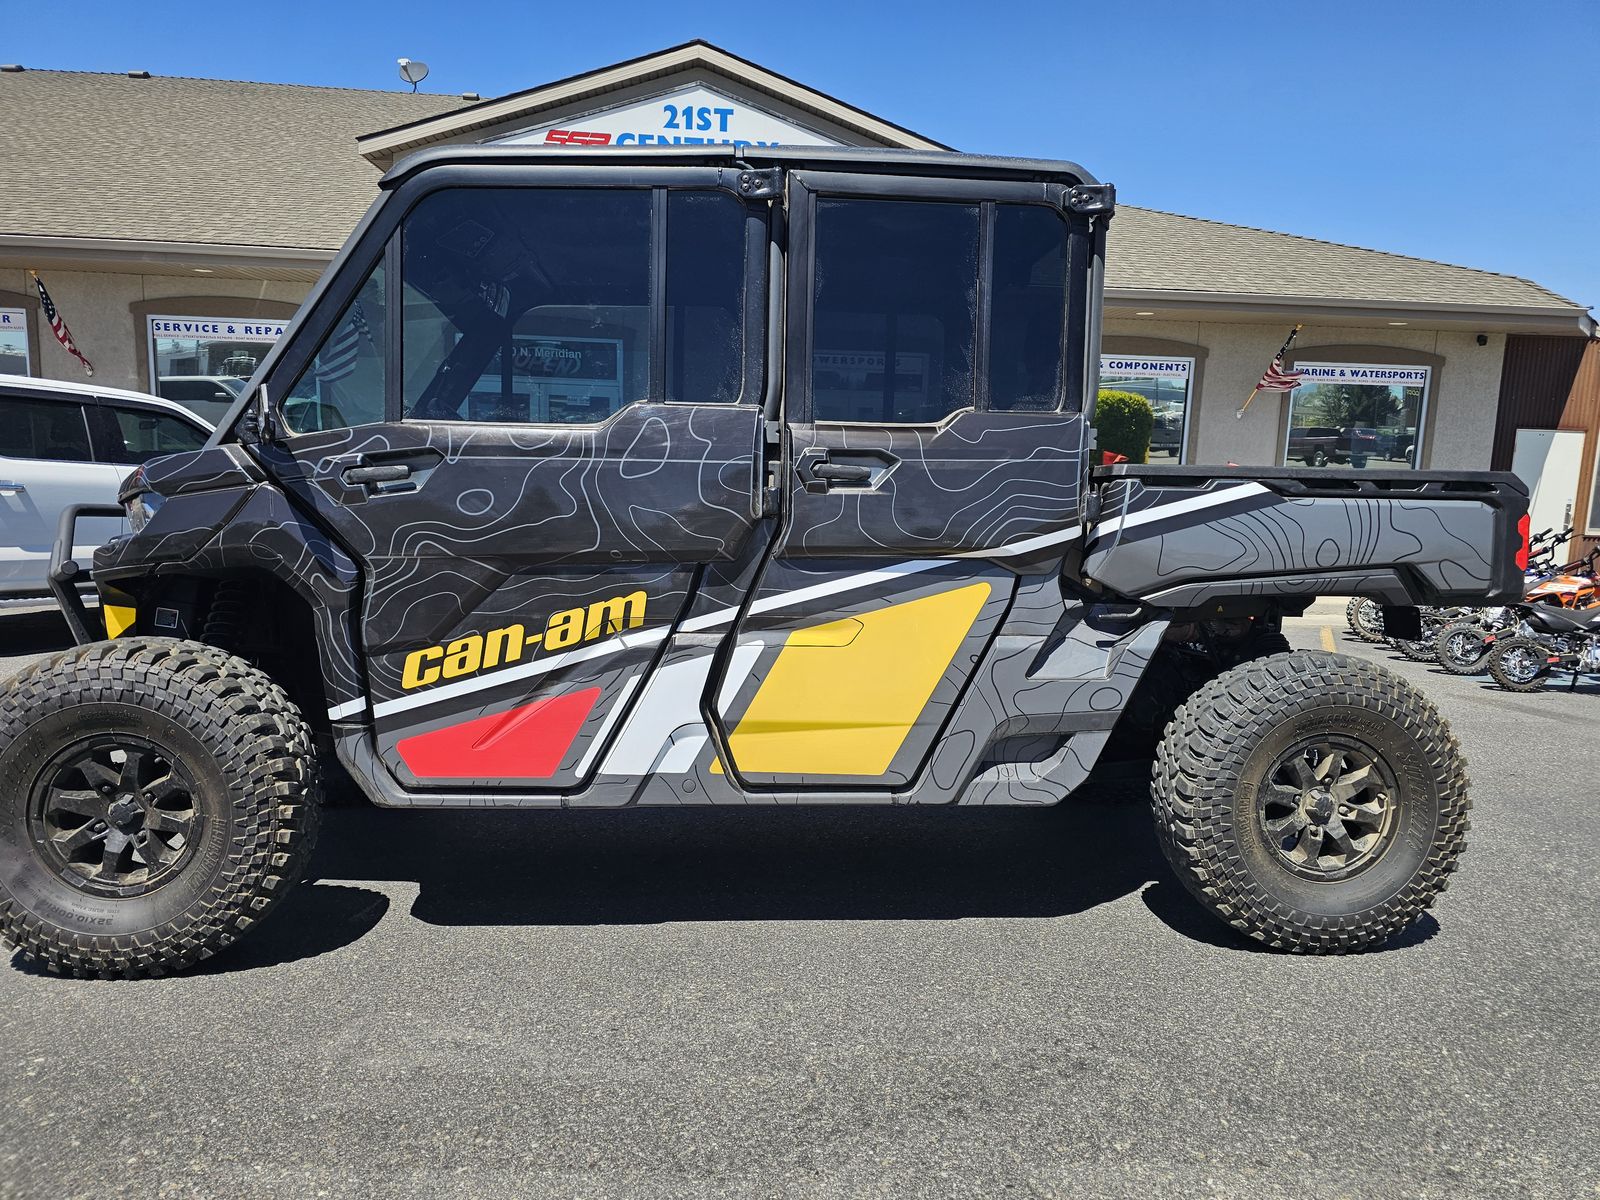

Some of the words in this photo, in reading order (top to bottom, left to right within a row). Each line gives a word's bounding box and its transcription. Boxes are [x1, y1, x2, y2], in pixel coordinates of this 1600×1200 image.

[663, 104, 735, 133] 21ST
[155, 322, 219, 333] SERVICE
[227, 325, 236, 334] &
[534, 347, 582, 359] Meridian
[1108, 361, 1187, 372] COMPONENTS
[1339, 369, 1346, 377] &
[1350, 369, 1425, 380] WATERSPORTS
[401, 590, 648, 689] can-am
